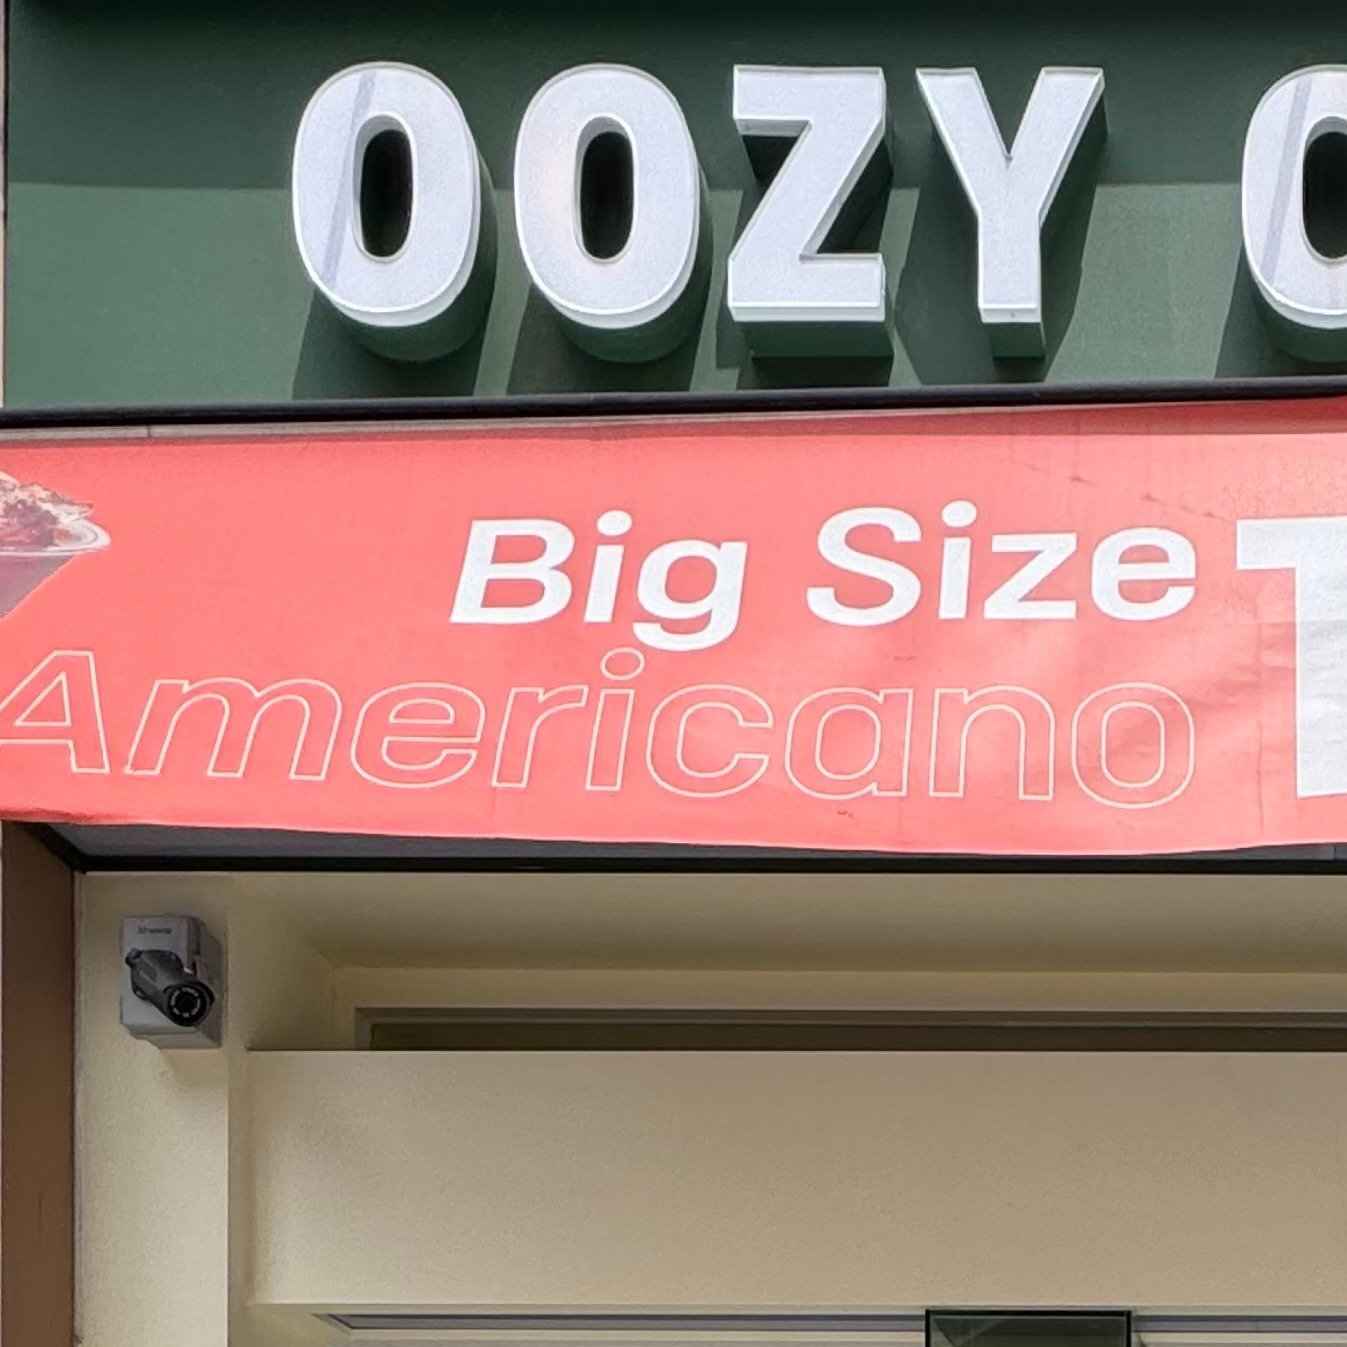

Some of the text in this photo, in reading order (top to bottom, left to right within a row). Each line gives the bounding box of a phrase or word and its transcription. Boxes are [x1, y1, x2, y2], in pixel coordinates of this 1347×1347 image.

[292, 61, 1107, 335] OOZY
[449, 499, 1197, 652] Big Size
[0, 646, 1196, 810] Americano
